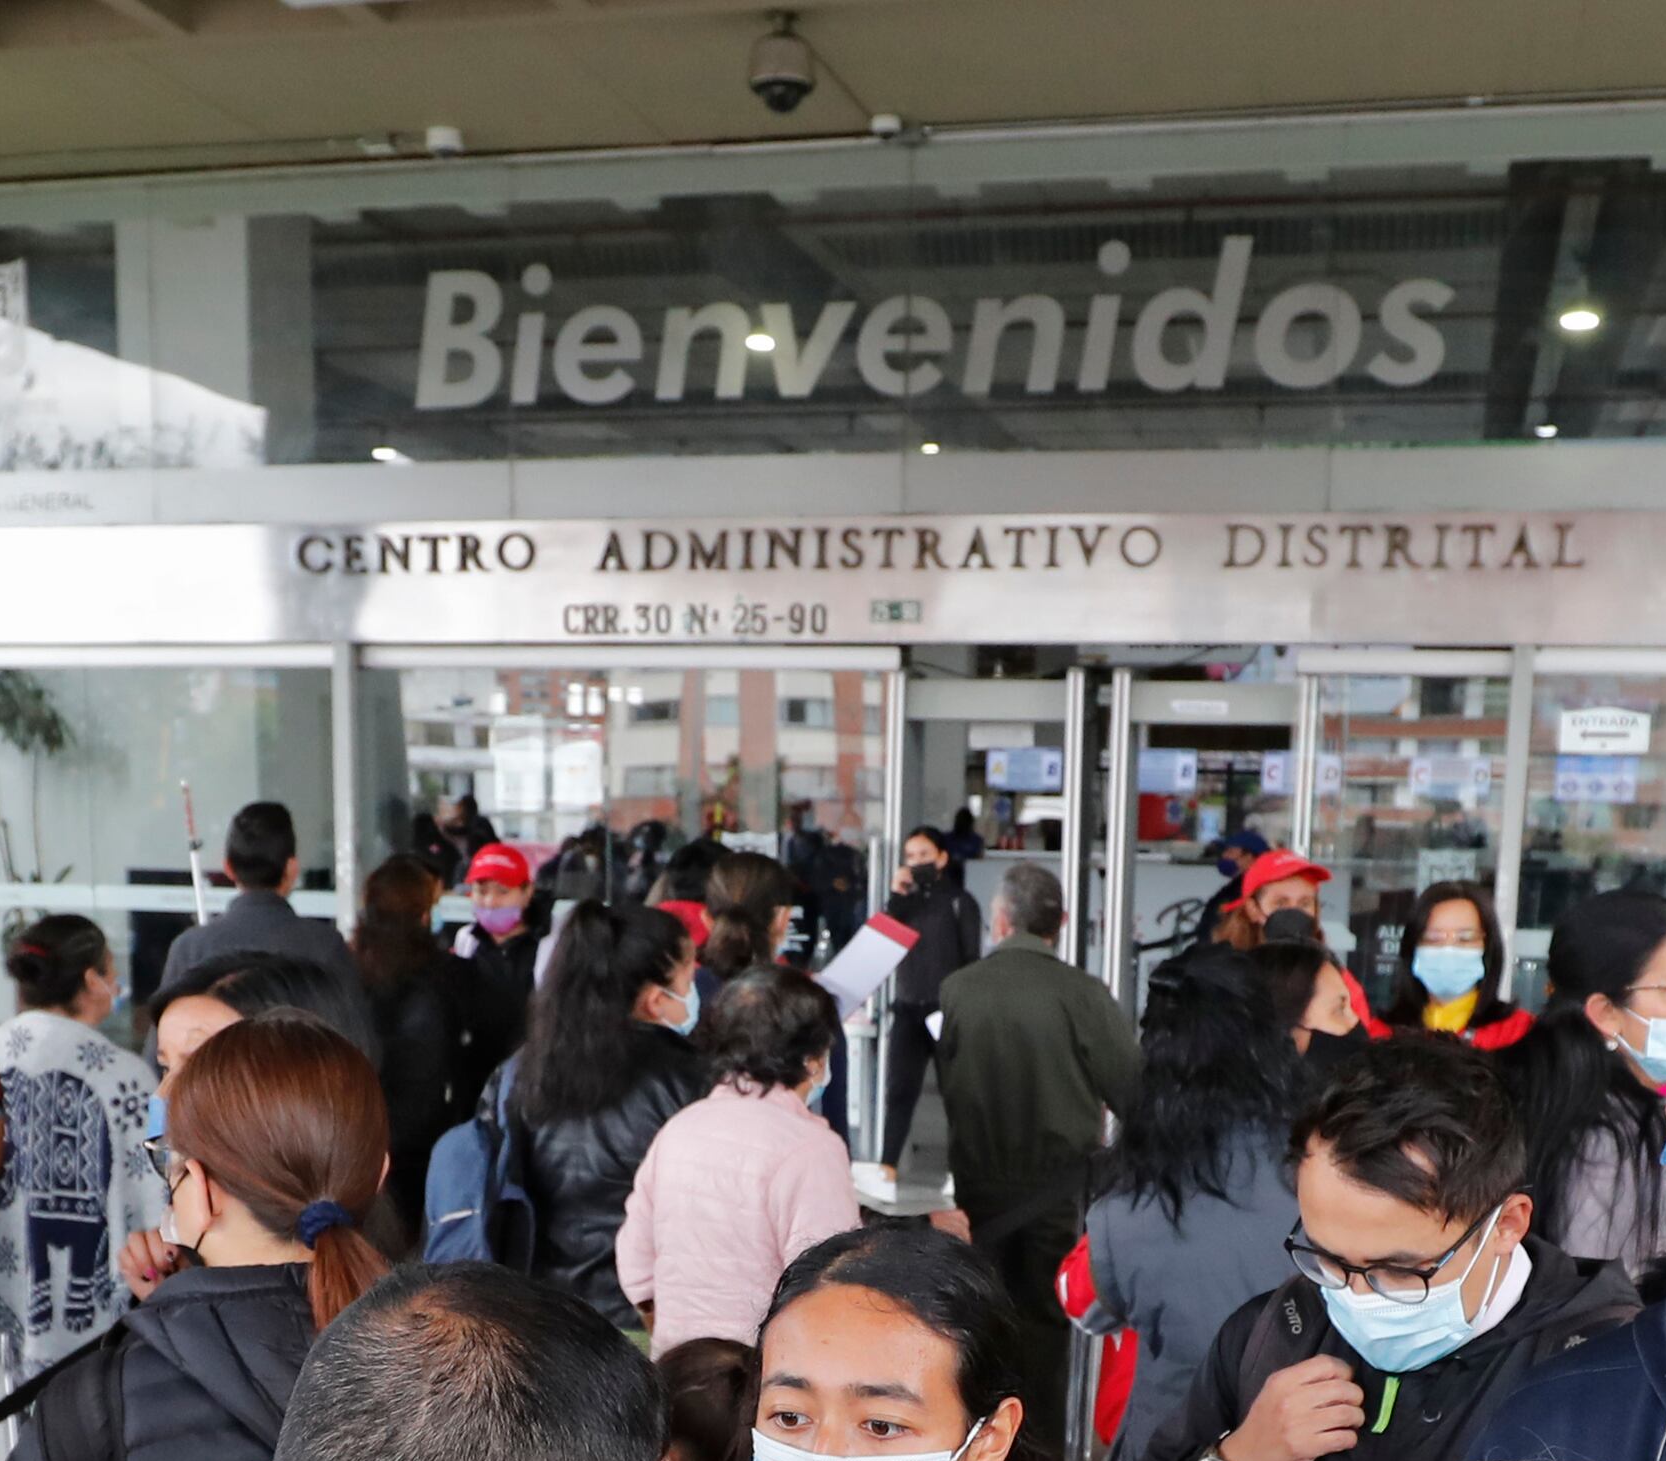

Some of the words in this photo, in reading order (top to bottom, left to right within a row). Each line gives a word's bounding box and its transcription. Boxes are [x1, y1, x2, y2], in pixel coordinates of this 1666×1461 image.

[412, 235, 1455, 411] Bienvenidos
[297, 533, 537, 573] CENTRO
[596, 524, 1162, 571] ADMINISTRATIVO
[1222, 523, 1586, 570] DISTRITAL
[732, 602, 828, 635] 25-90
[1570, 715, 1640, 728] ENTRADA
